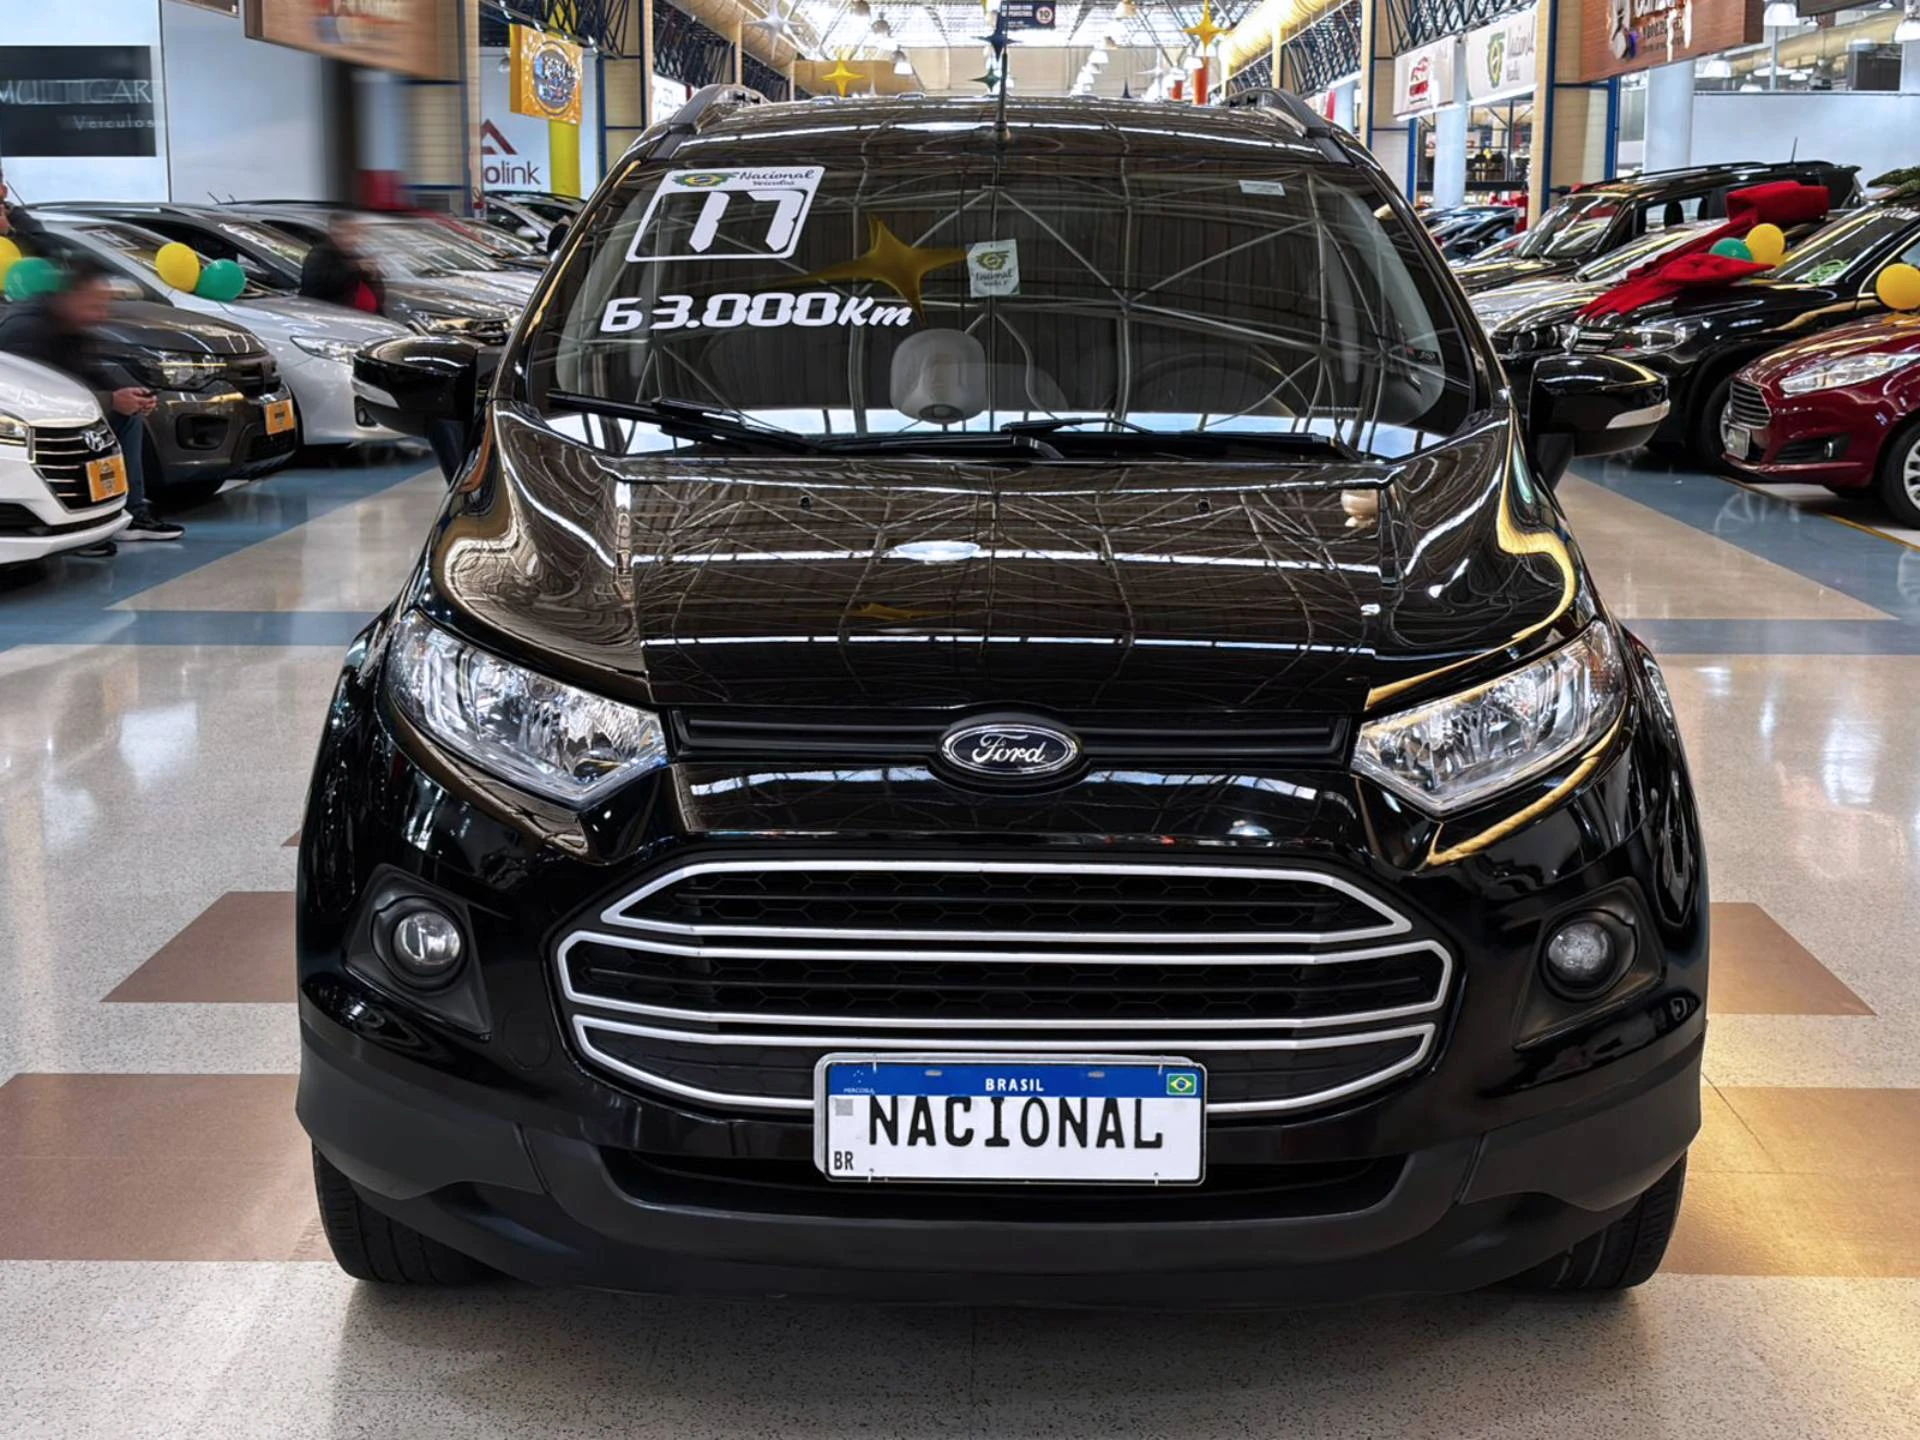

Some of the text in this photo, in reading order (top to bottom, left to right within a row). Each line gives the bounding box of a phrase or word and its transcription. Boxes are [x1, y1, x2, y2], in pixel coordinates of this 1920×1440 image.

[739, 169, 815, 180] Nacional
[688, 190, 805, 252] 17
[972, 733, 1047, 763] Ford
[985, 1078, 1045, 1092] BRASIL
[868, 1095, 1163, 1149] NACIONAL
[833, 1150, 854, 1171] BR
